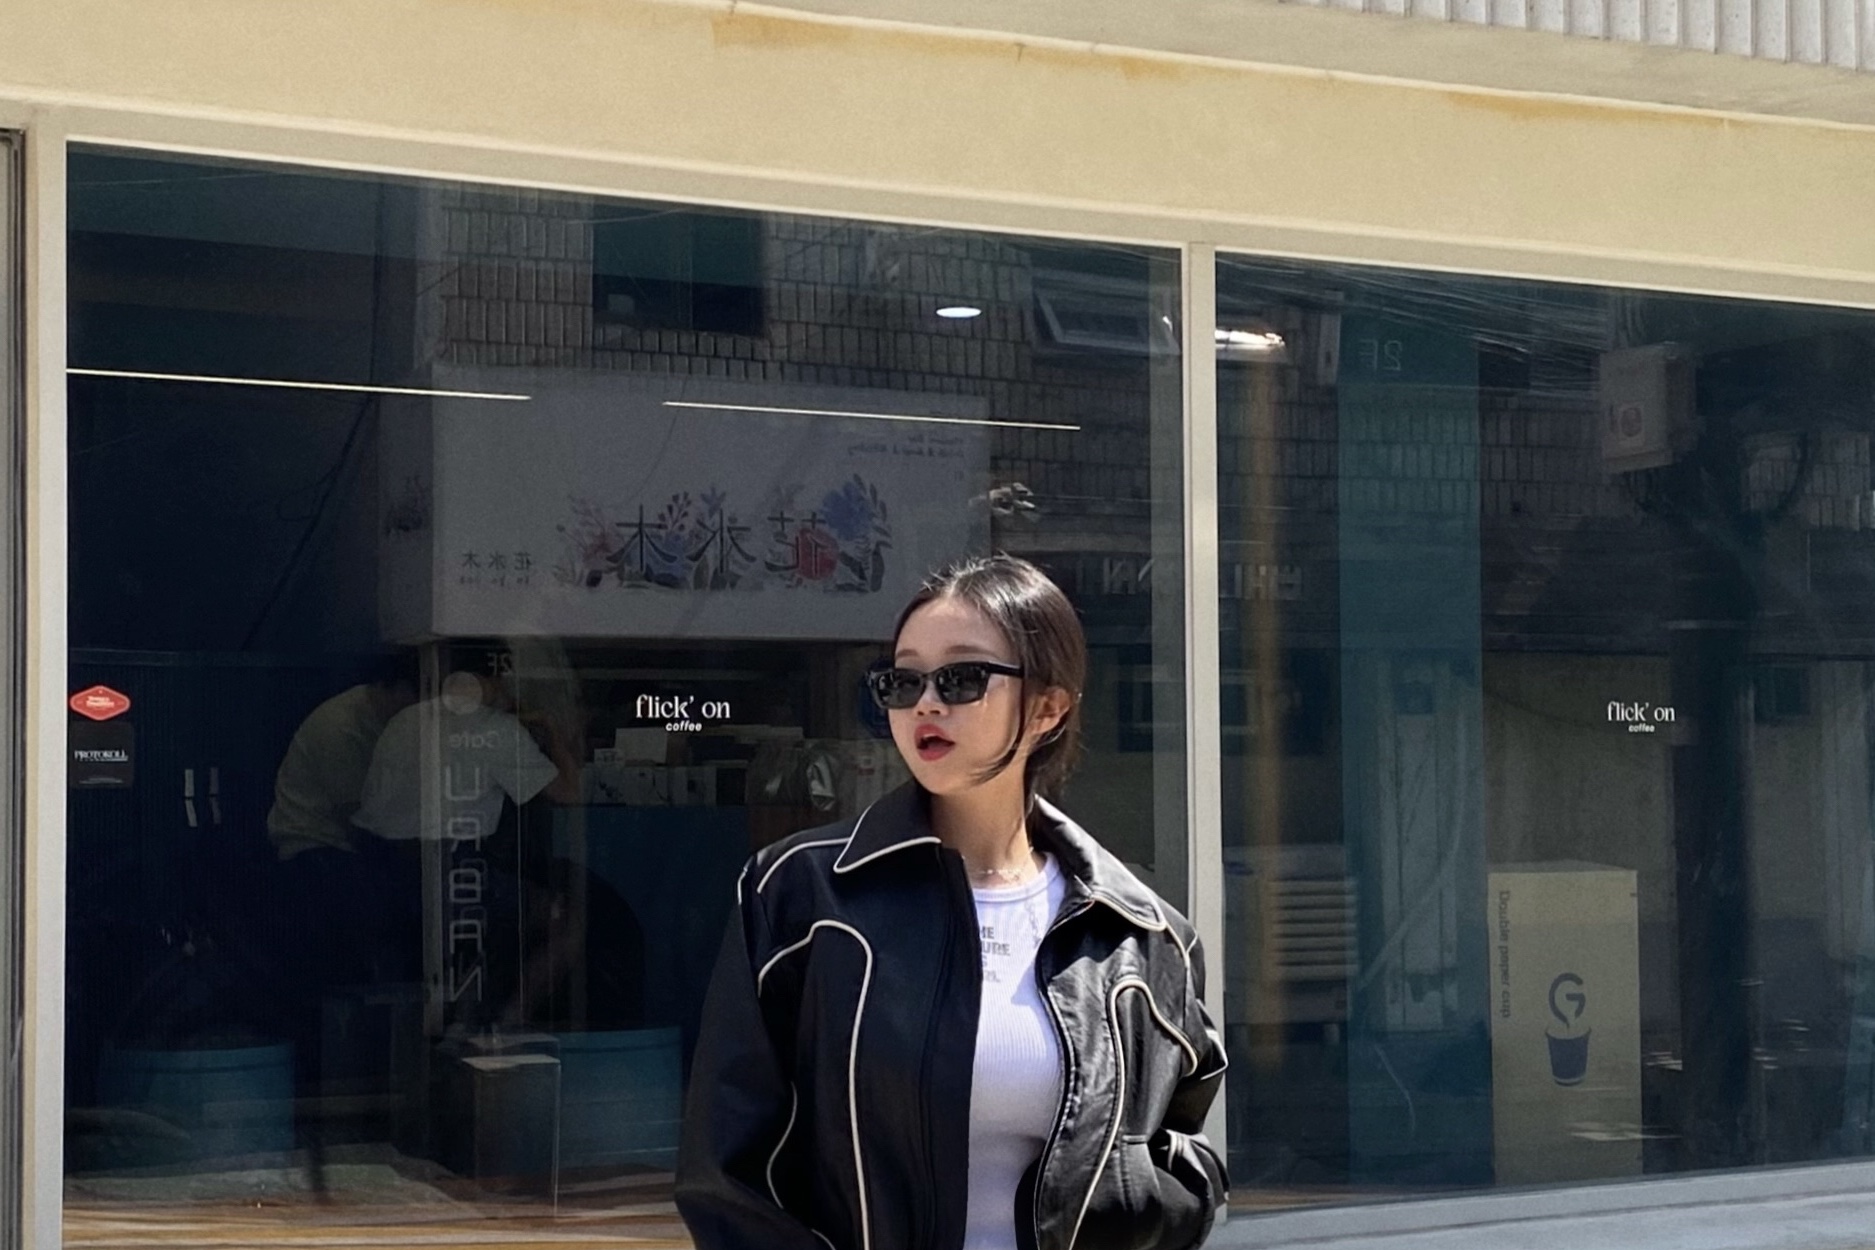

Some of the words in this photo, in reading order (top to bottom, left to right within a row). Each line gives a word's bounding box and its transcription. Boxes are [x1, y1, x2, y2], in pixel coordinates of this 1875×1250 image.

[635, 693, 695, 719] flick'
[701, 701, 731, 719] on
[1607, 700, 1650, 722] flick'
[1653, 706, 1676, 722] on
[665, 720, 702, 732] coffee
[1628, 722, 1655, 733] coffee
[1498, 890, 1511, 941] Double
[1499, 944, 1511, 987] paper
[1499, 990, 1511, 1019] cup
